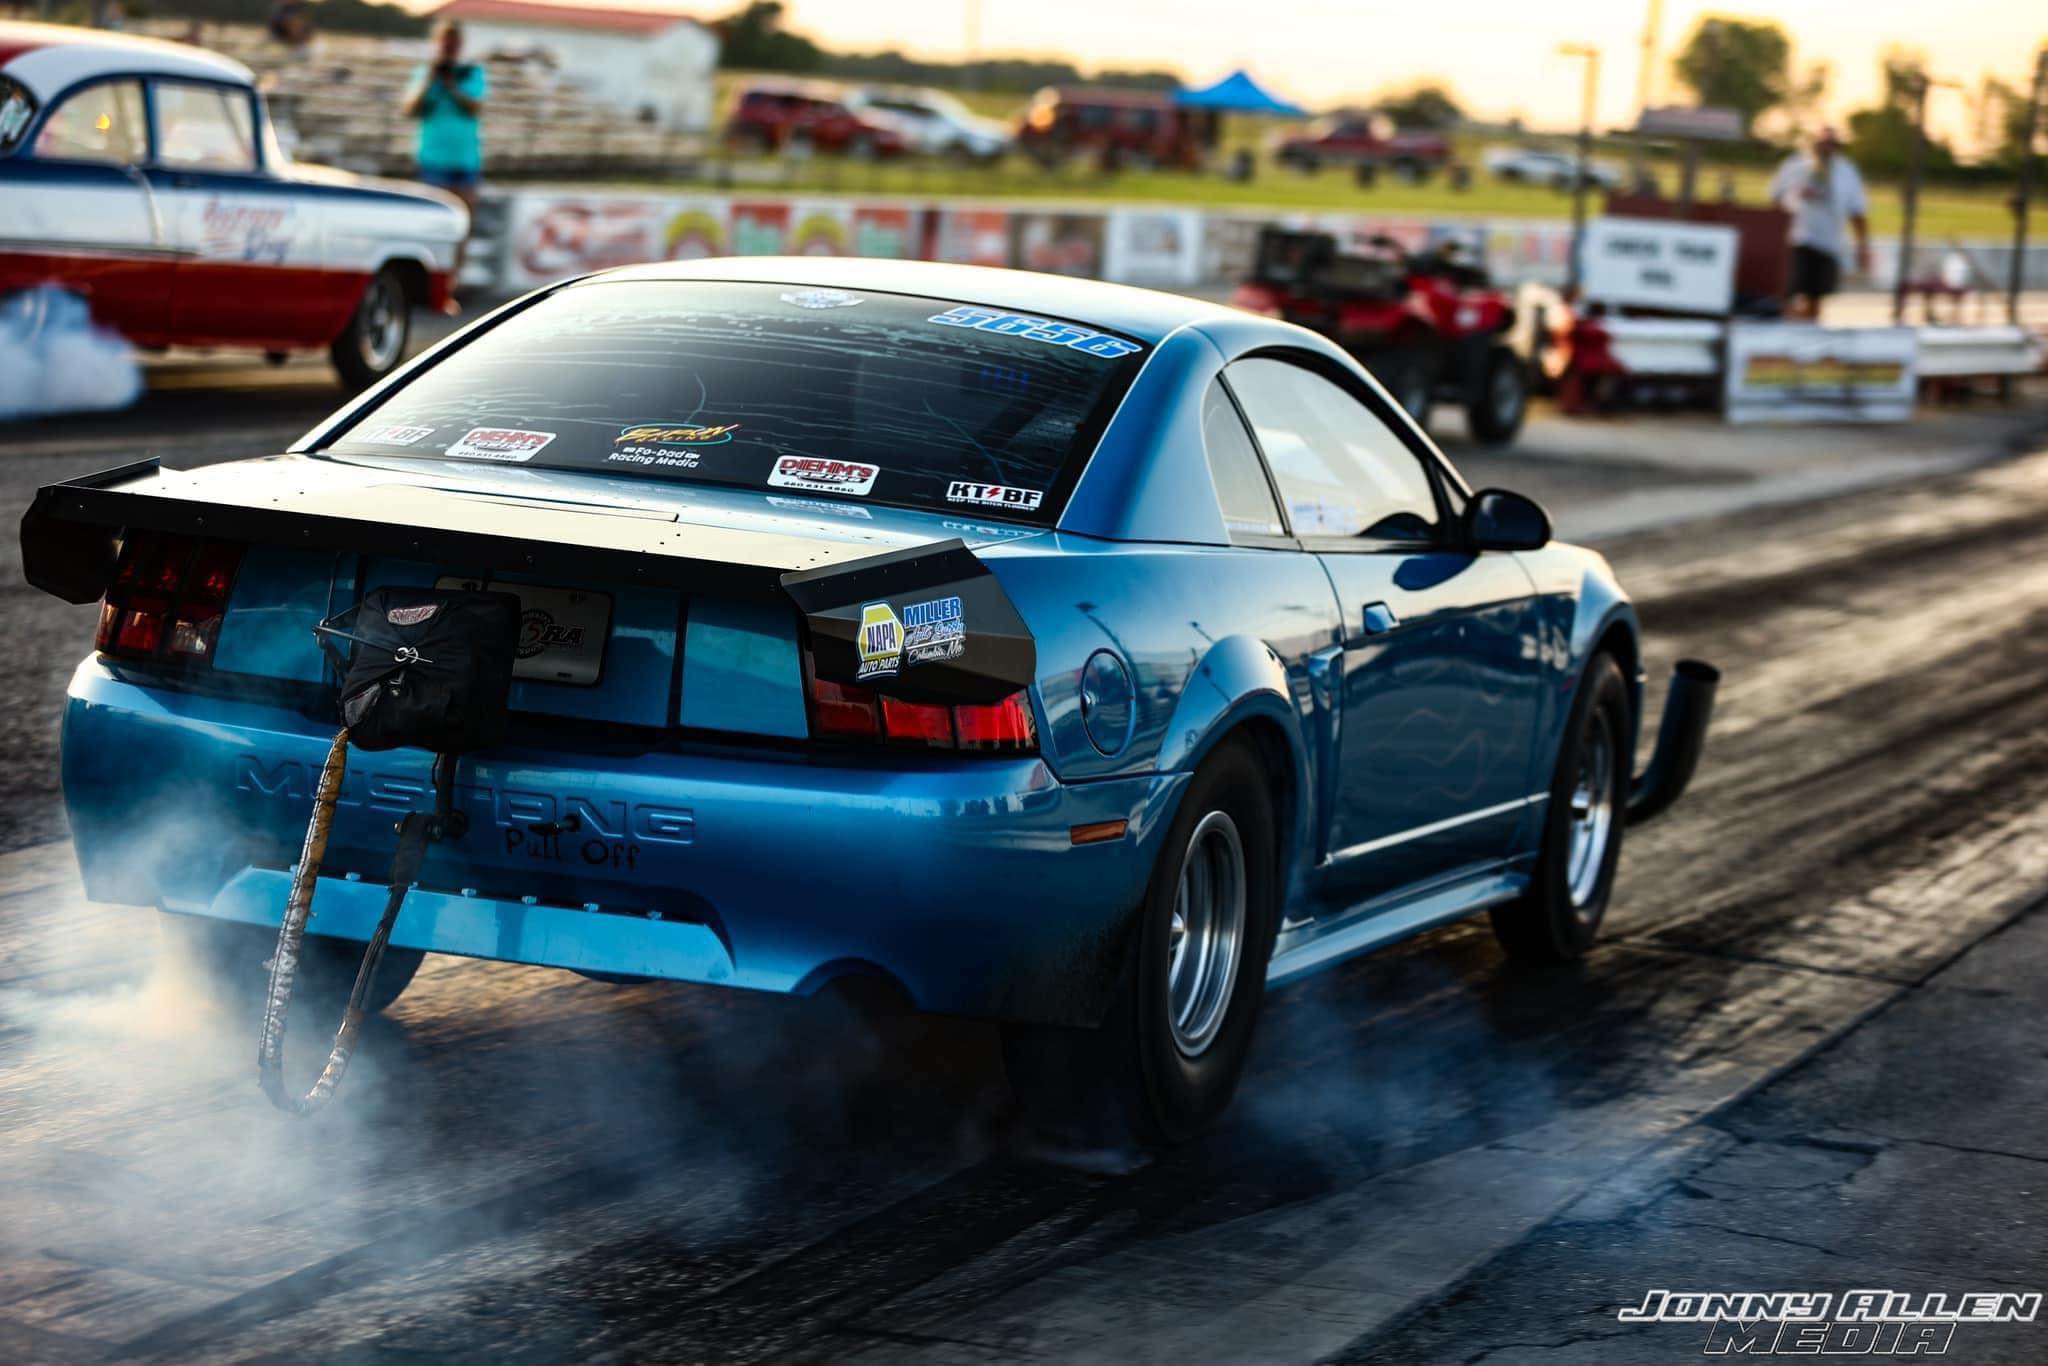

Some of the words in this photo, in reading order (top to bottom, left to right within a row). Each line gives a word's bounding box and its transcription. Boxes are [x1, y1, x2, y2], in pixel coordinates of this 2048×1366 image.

[928, 305, 1142, 359] 5656
[608, 453, 654, 465] Racing
[656, 457, 699, 469] Media
[904, 598, 961, 628] MILLER
[866, 621, 897, 654] NAPA
[858, 660, 878, 674] AUTO
[878, 656, 901, 671] PARTS
